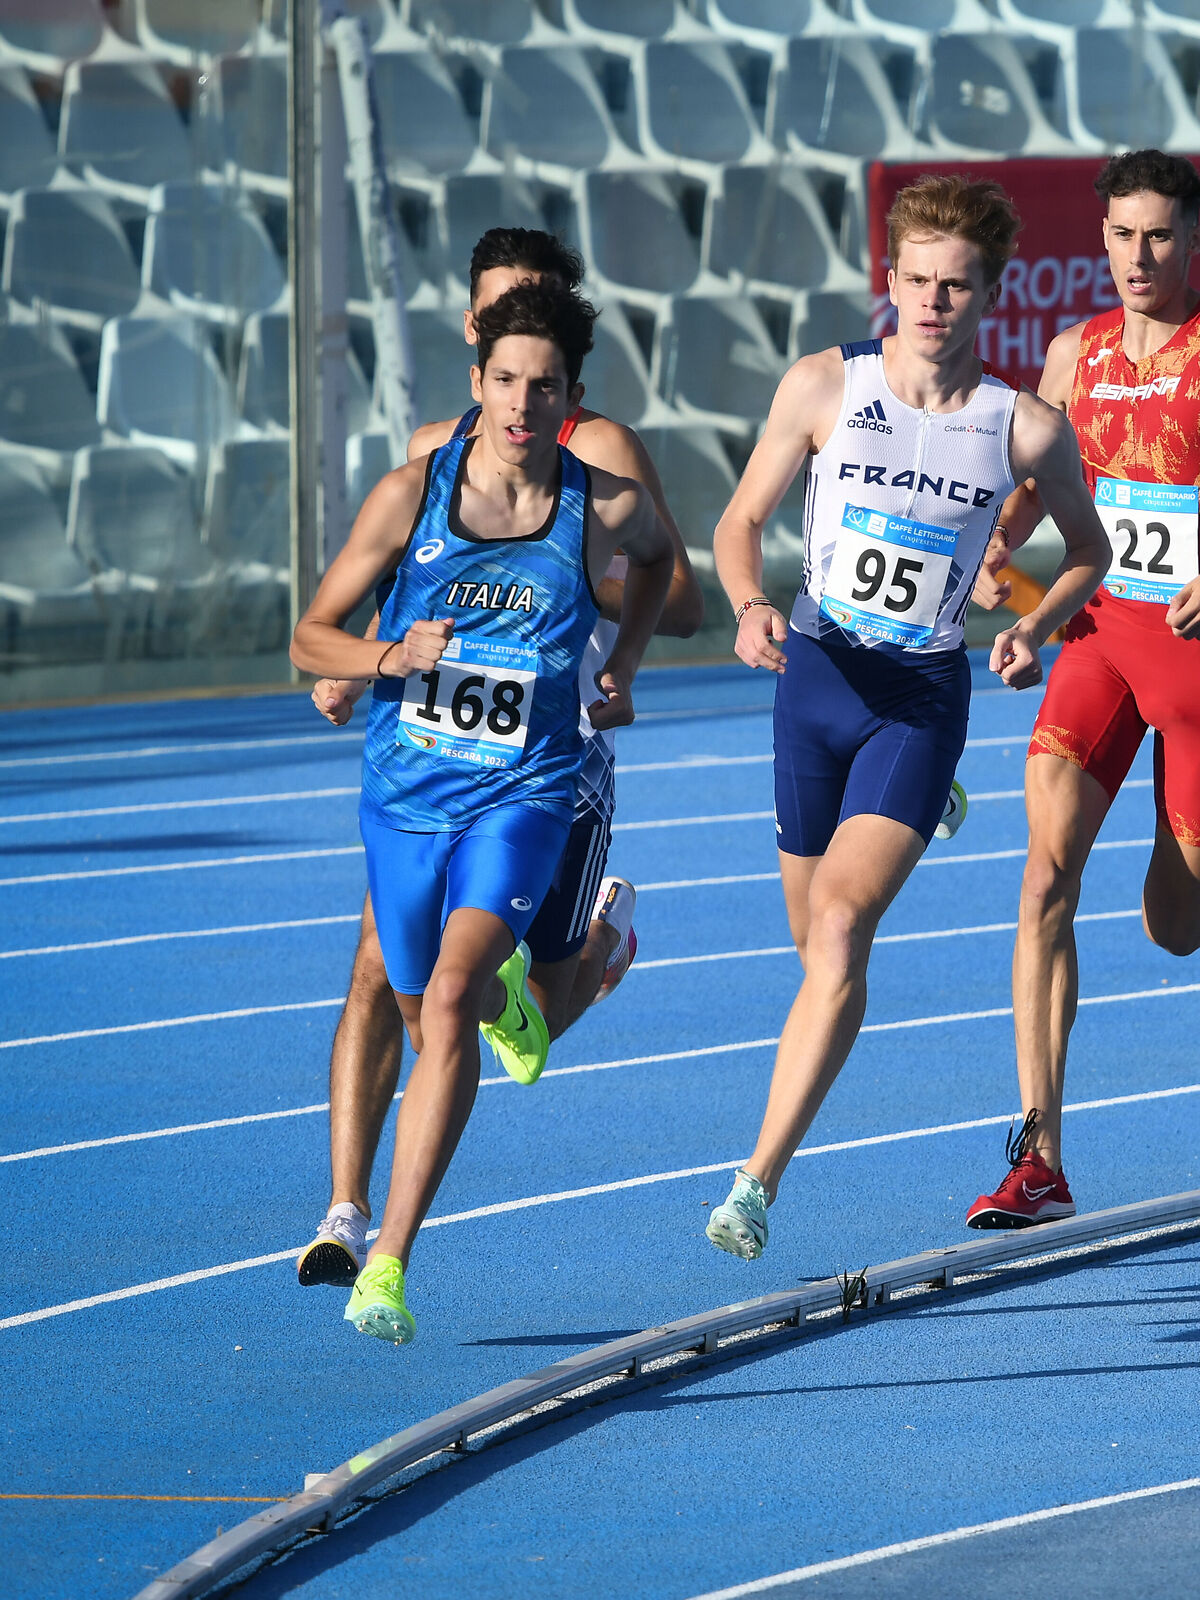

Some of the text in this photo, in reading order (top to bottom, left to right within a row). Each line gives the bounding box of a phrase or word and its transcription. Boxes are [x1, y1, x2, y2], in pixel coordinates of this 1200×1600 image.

[1090, 376, 1181, 401] ESPAÑA
[847, 418, 893, 435] adidas
[944, 425, 998, 436] Crédit Mutuel
[839, 462, 995, 508] FRANCE
[1153, 490, 1195, 500] LETTERARIO
[889, 521, 956, 543] CAFFÈ LETTERARIO
[1115, 518, 1174, 575] 22
[851, 548, 924, 613] 95
[446, 582, 533, 612] ITALIA
[1131, 591, 1165, 602] PESCARA
[855, 623, 893, 641] PESCARA
[895, 635, 916, 646] 2022
[464, 641, 537, 658] CAFFÈ LETTERARIO
[416, 670, 525, 736] 168
[440, 747, 507, 767] PESCARA 2022
